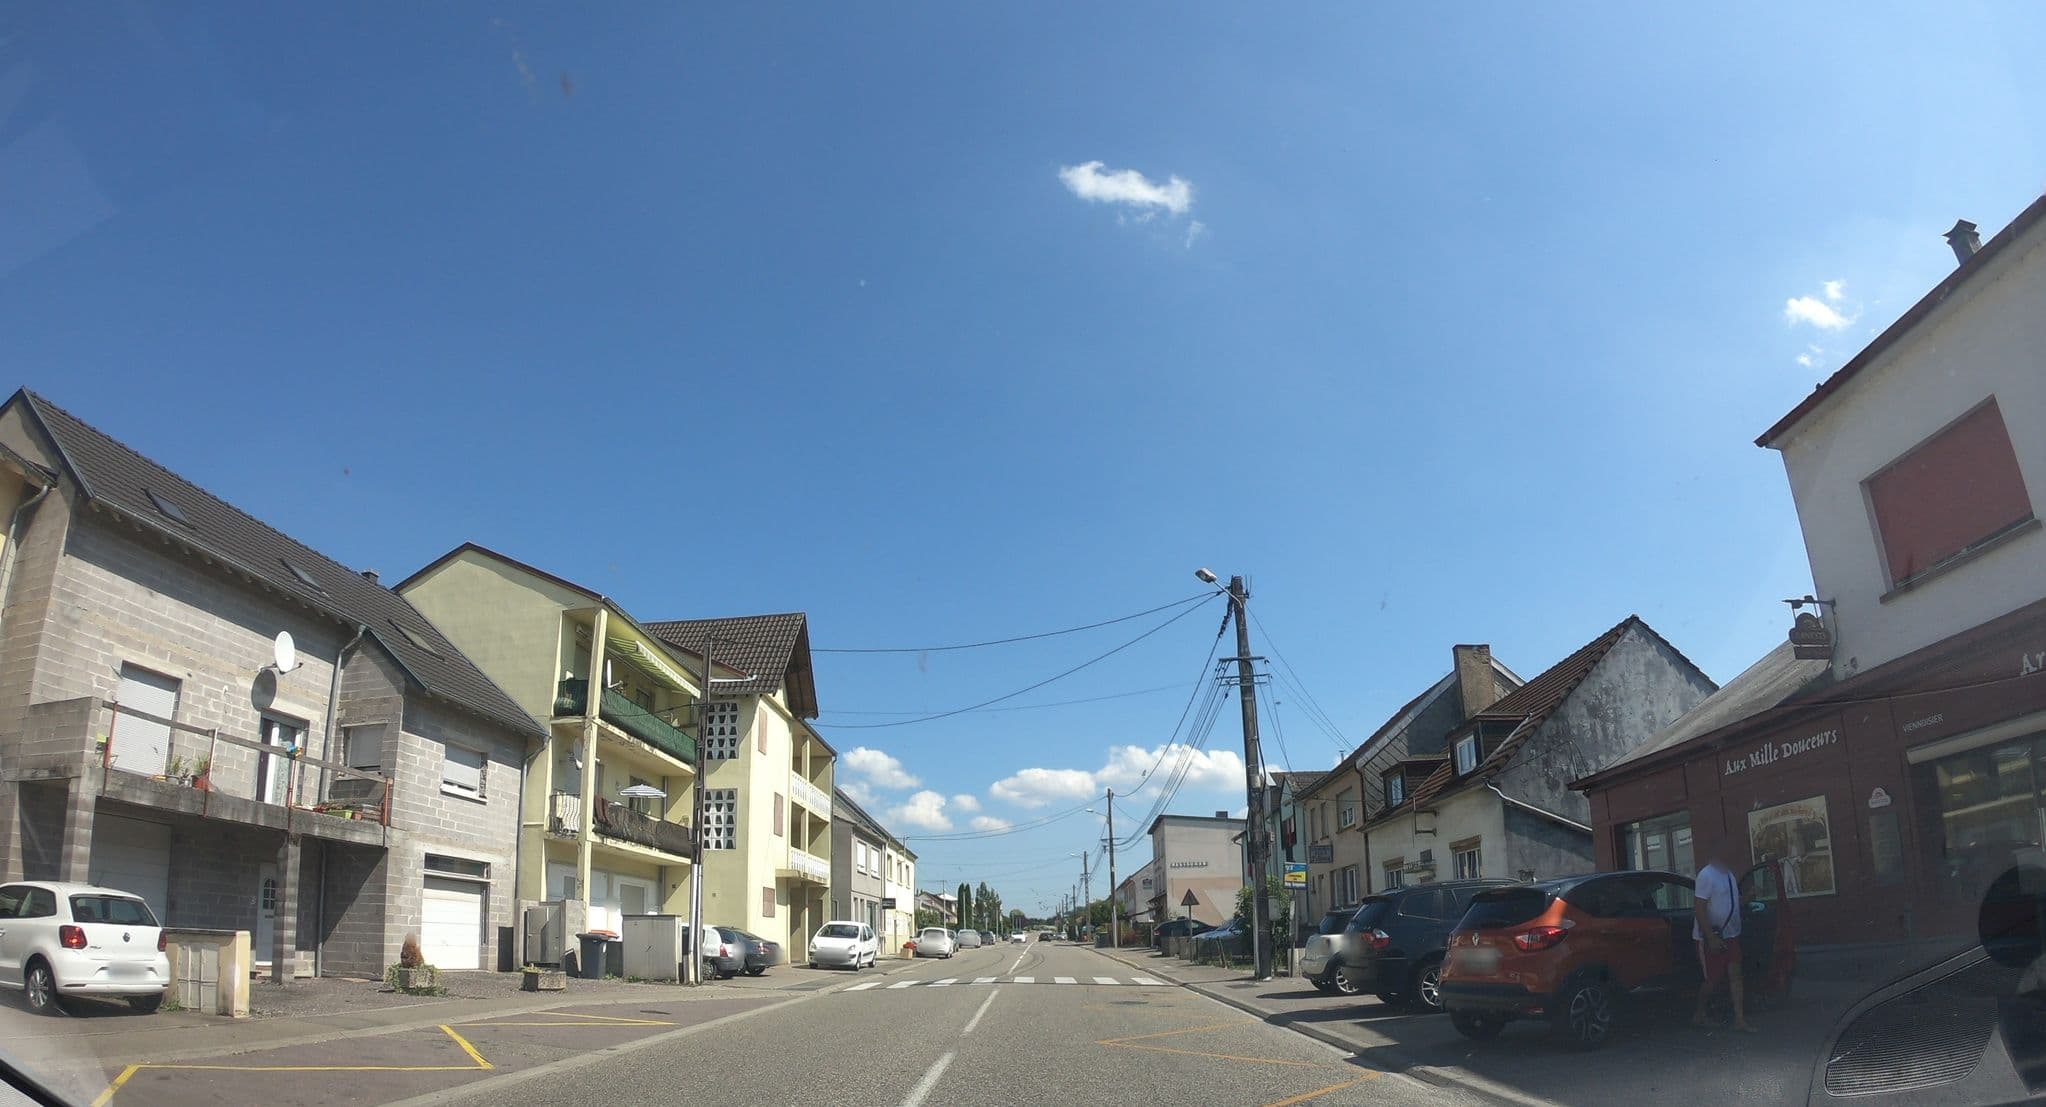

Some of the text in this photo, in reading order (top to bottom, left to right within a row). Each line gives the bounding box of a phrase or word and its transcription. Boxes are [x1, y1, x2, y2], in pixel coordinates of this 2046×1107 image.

[1725, 729, 1837, 775] Aux Mille Douceurs
